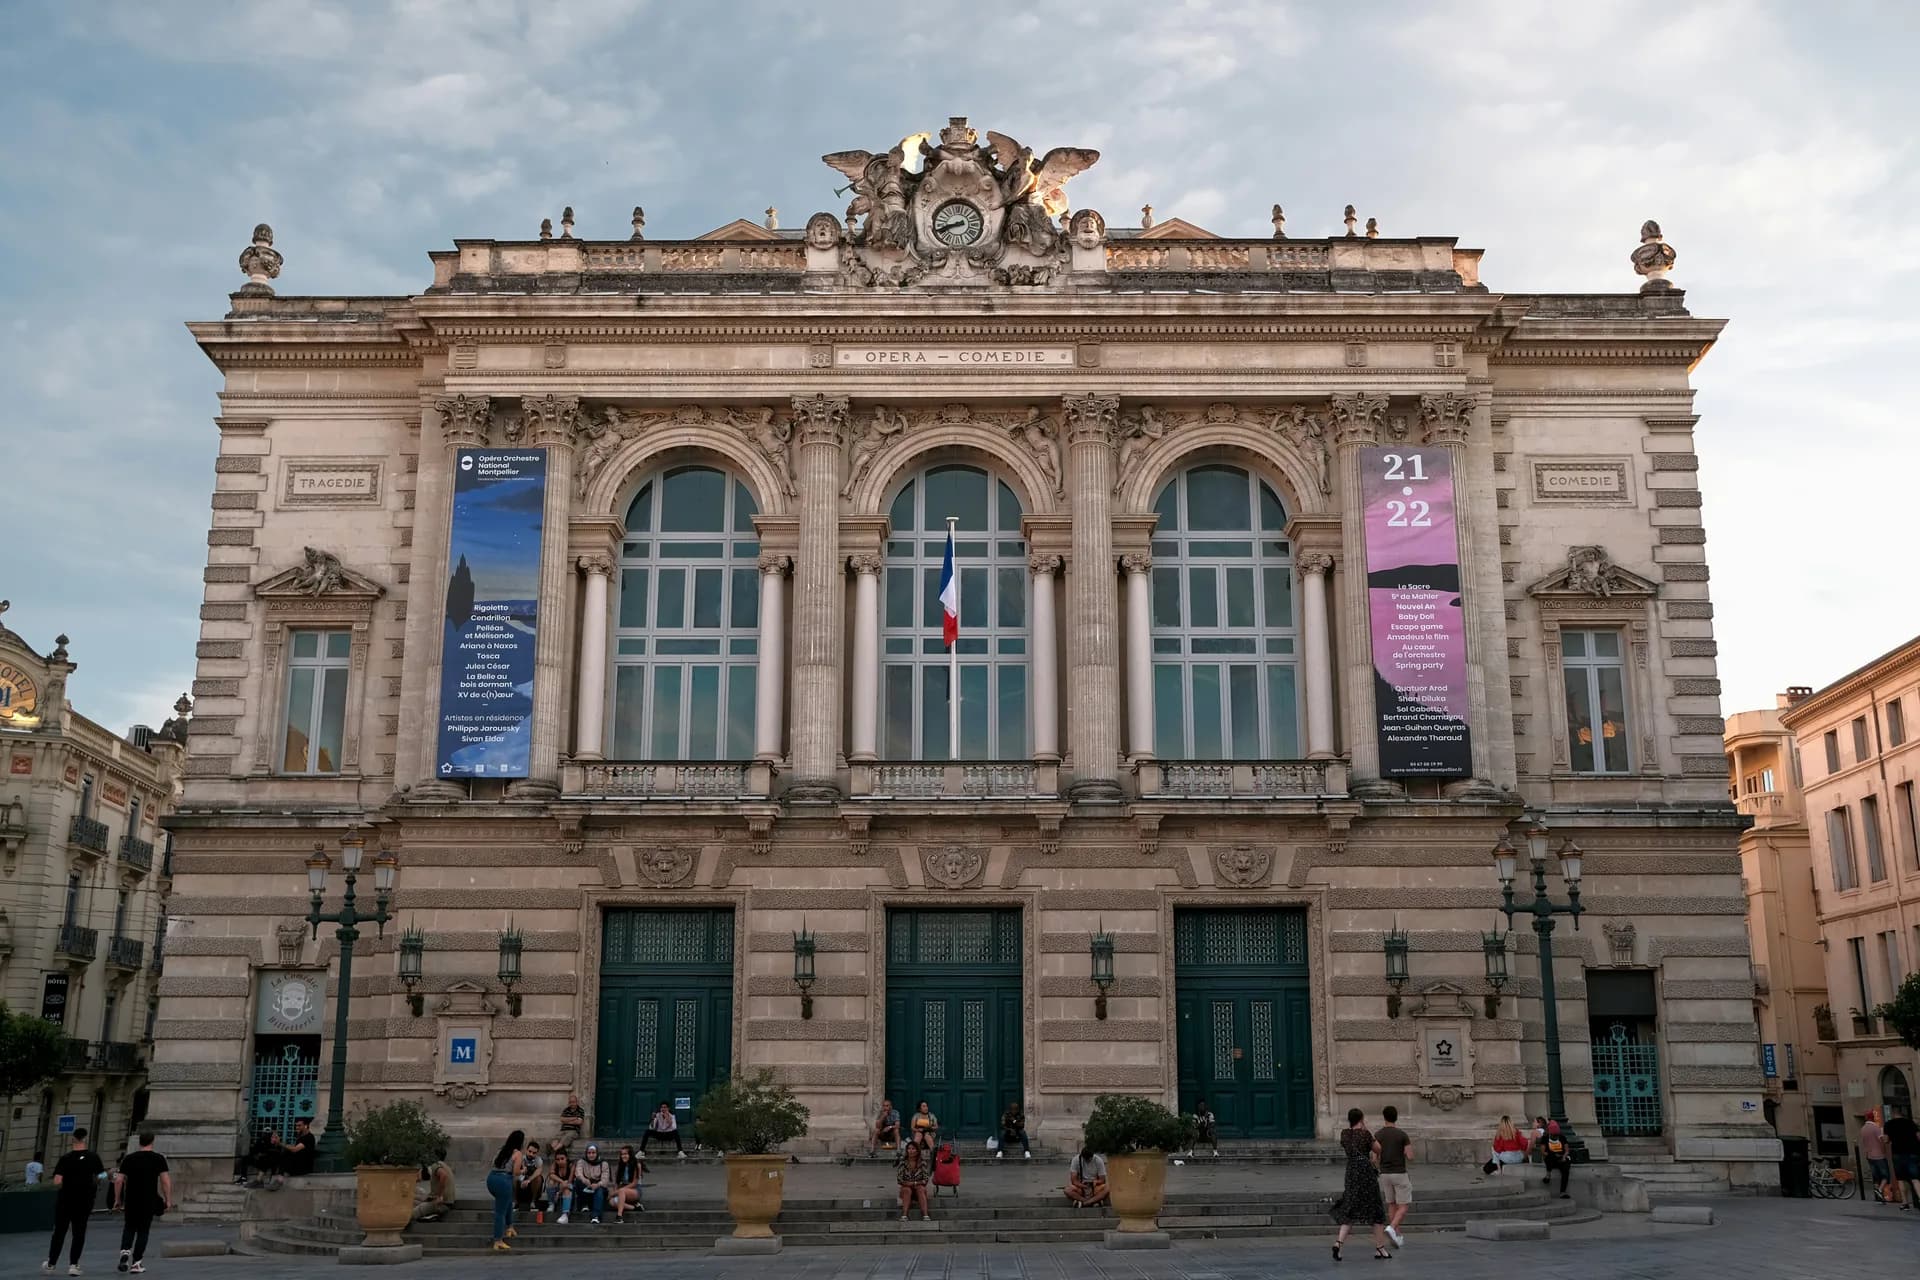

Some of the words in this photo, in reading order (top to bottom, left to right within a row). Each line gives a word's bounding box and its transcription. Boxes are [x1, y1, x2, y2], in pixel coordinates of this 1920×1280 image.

[866, 352, 926, 362] OPERA
[959, 352, 1045, 362] COMEDIE
[1383, 454, 1428, 480] 21
[300, 479, 365, 488] TRAGEDIE
[1550, 477, 1612, 485] COMEDIE
[1386, 501, 1432, 526] 22
[0, 664, 32, 698] OTEL
[456, 1046, 471, 1059] M
